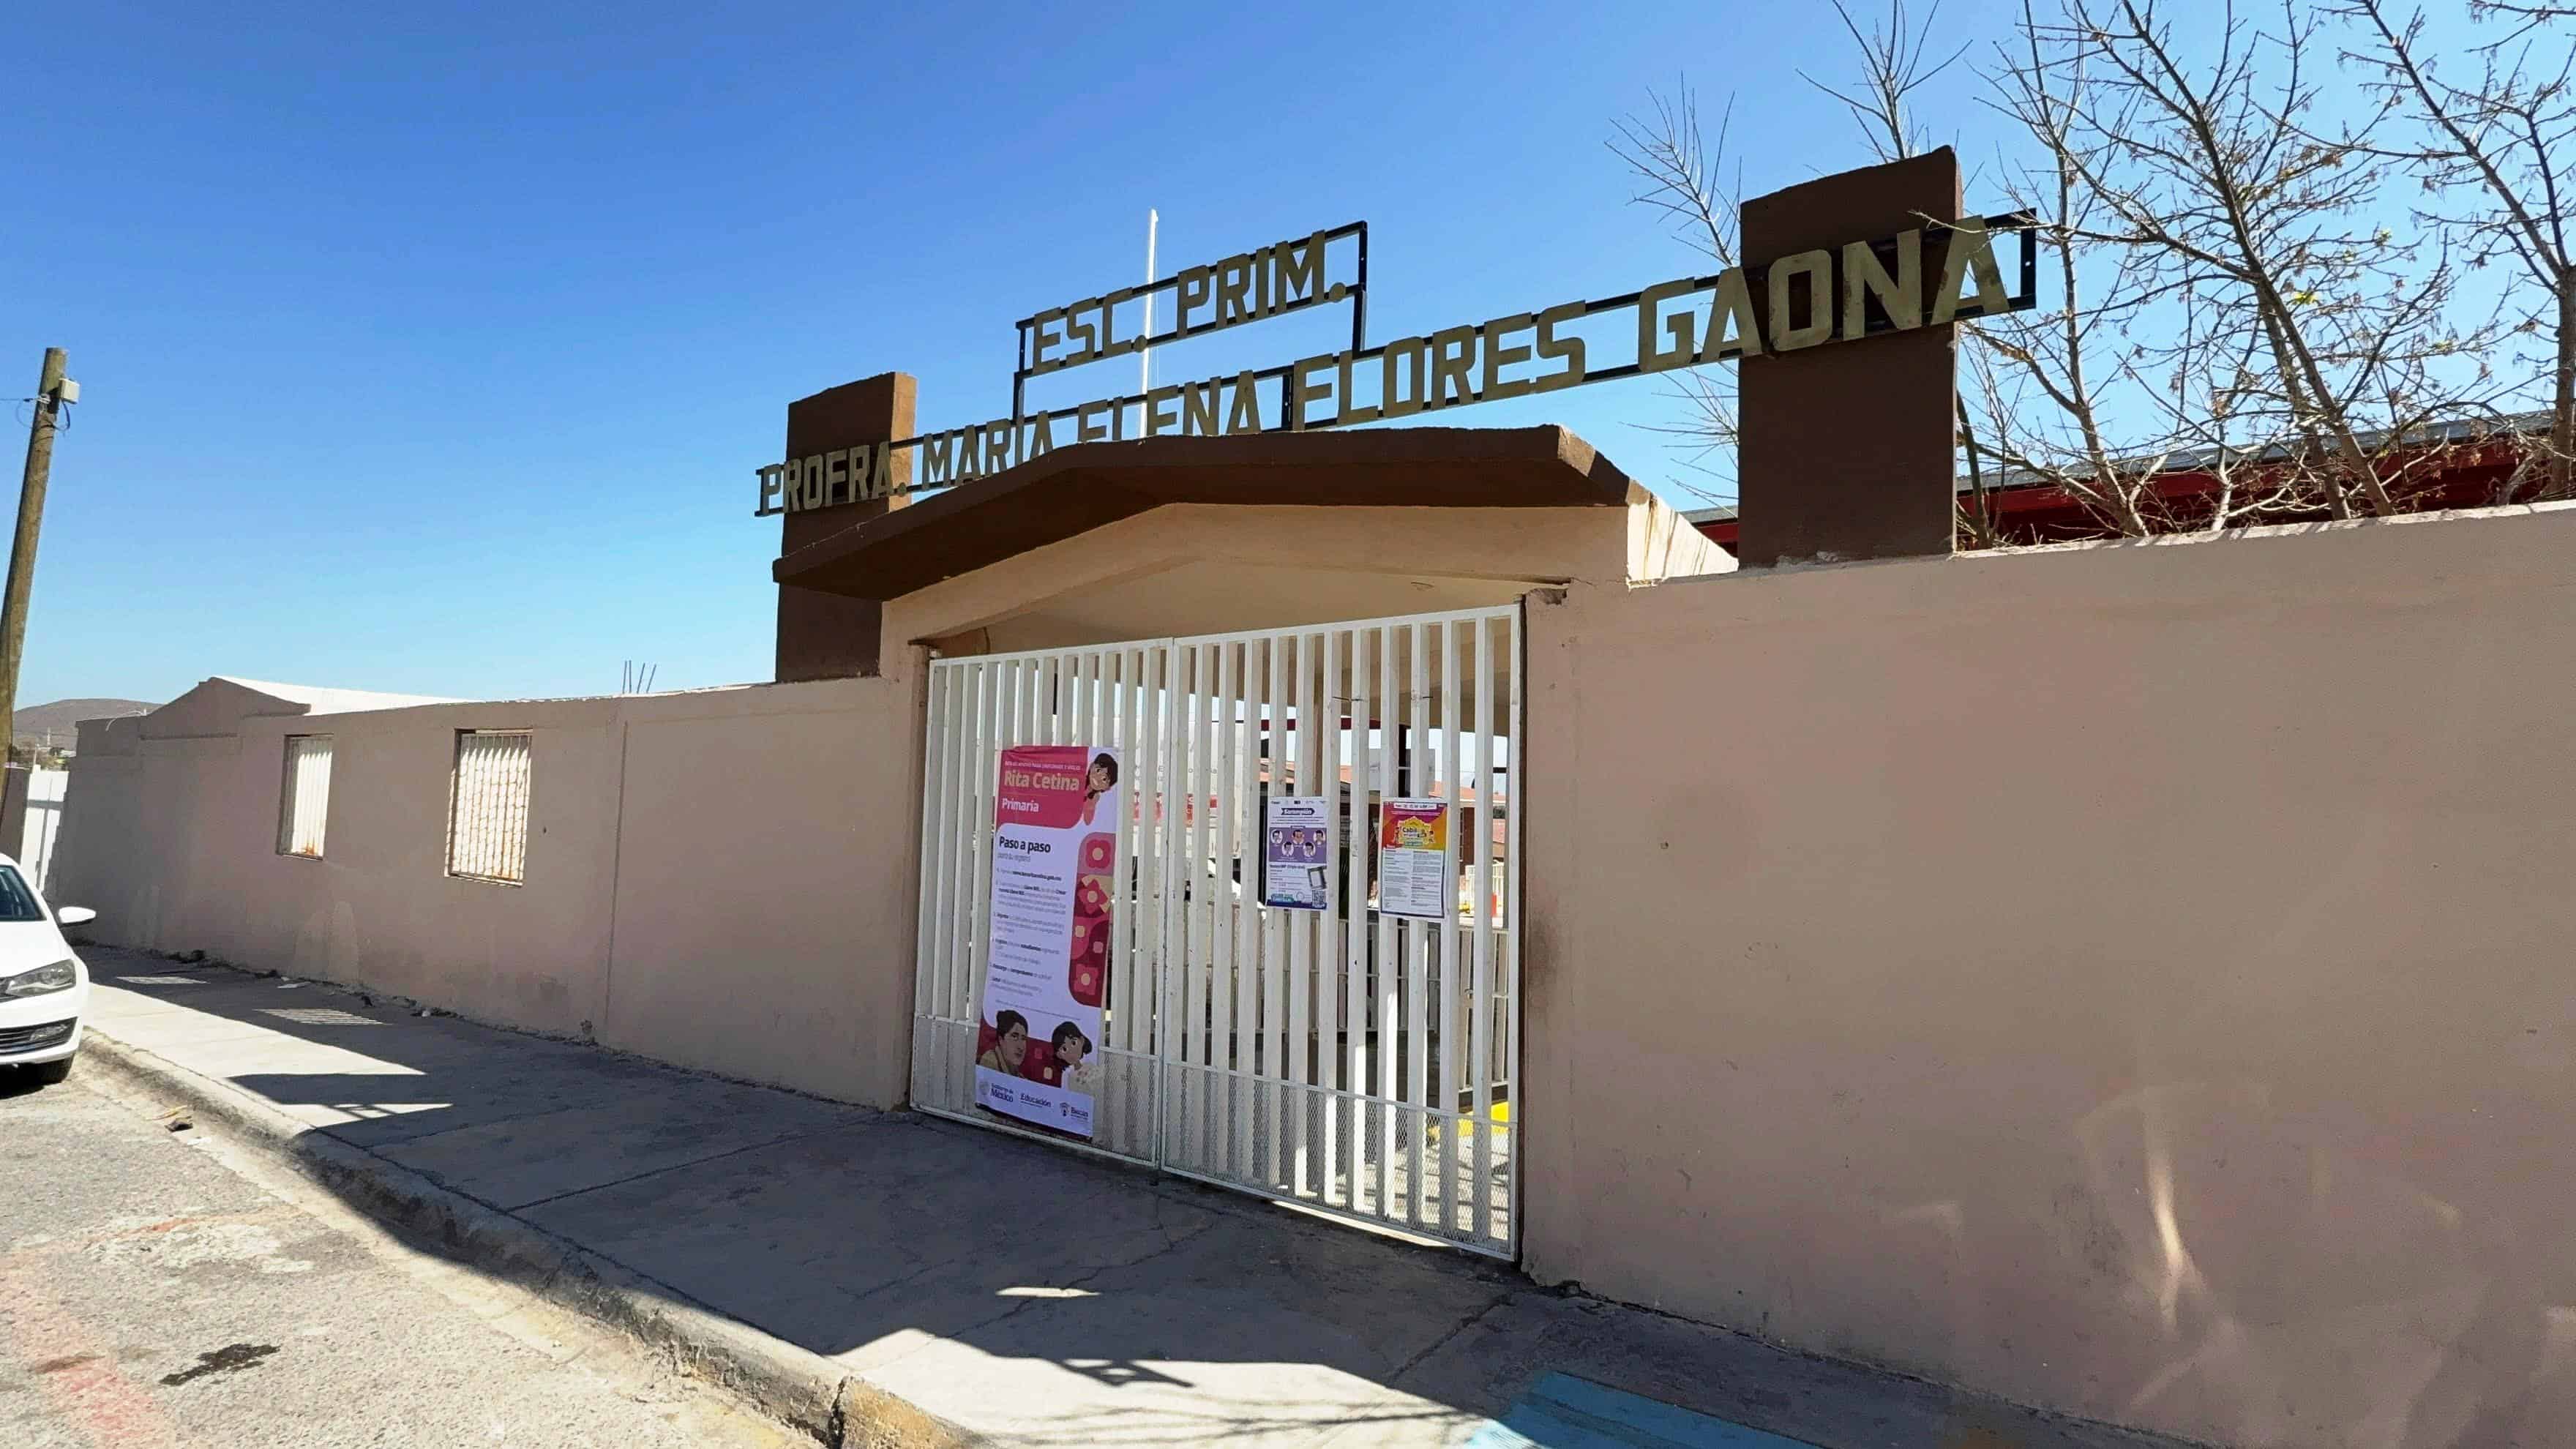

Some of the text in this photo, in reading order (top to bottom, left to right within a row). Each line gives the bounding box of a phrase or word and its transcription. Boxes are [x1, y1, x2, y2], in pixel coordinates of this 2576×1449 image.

[1032, 231, 1347, 375] ESC. PRIM.
[760, 442, 907, 515] PROFRA.
[921, 410, 1052, 491] MARIA
[1292, 299, 1587, 431] FLORES
[1637, 214, 2010, 373] GAONA
[1004, 771, 1080, 791] Rita Cetina
[1002, 798, 1039, 812] Primaria
[1000, 836, 1052, 855] Paso a paso
[1020, 1093, 1052, 1108] Educación
